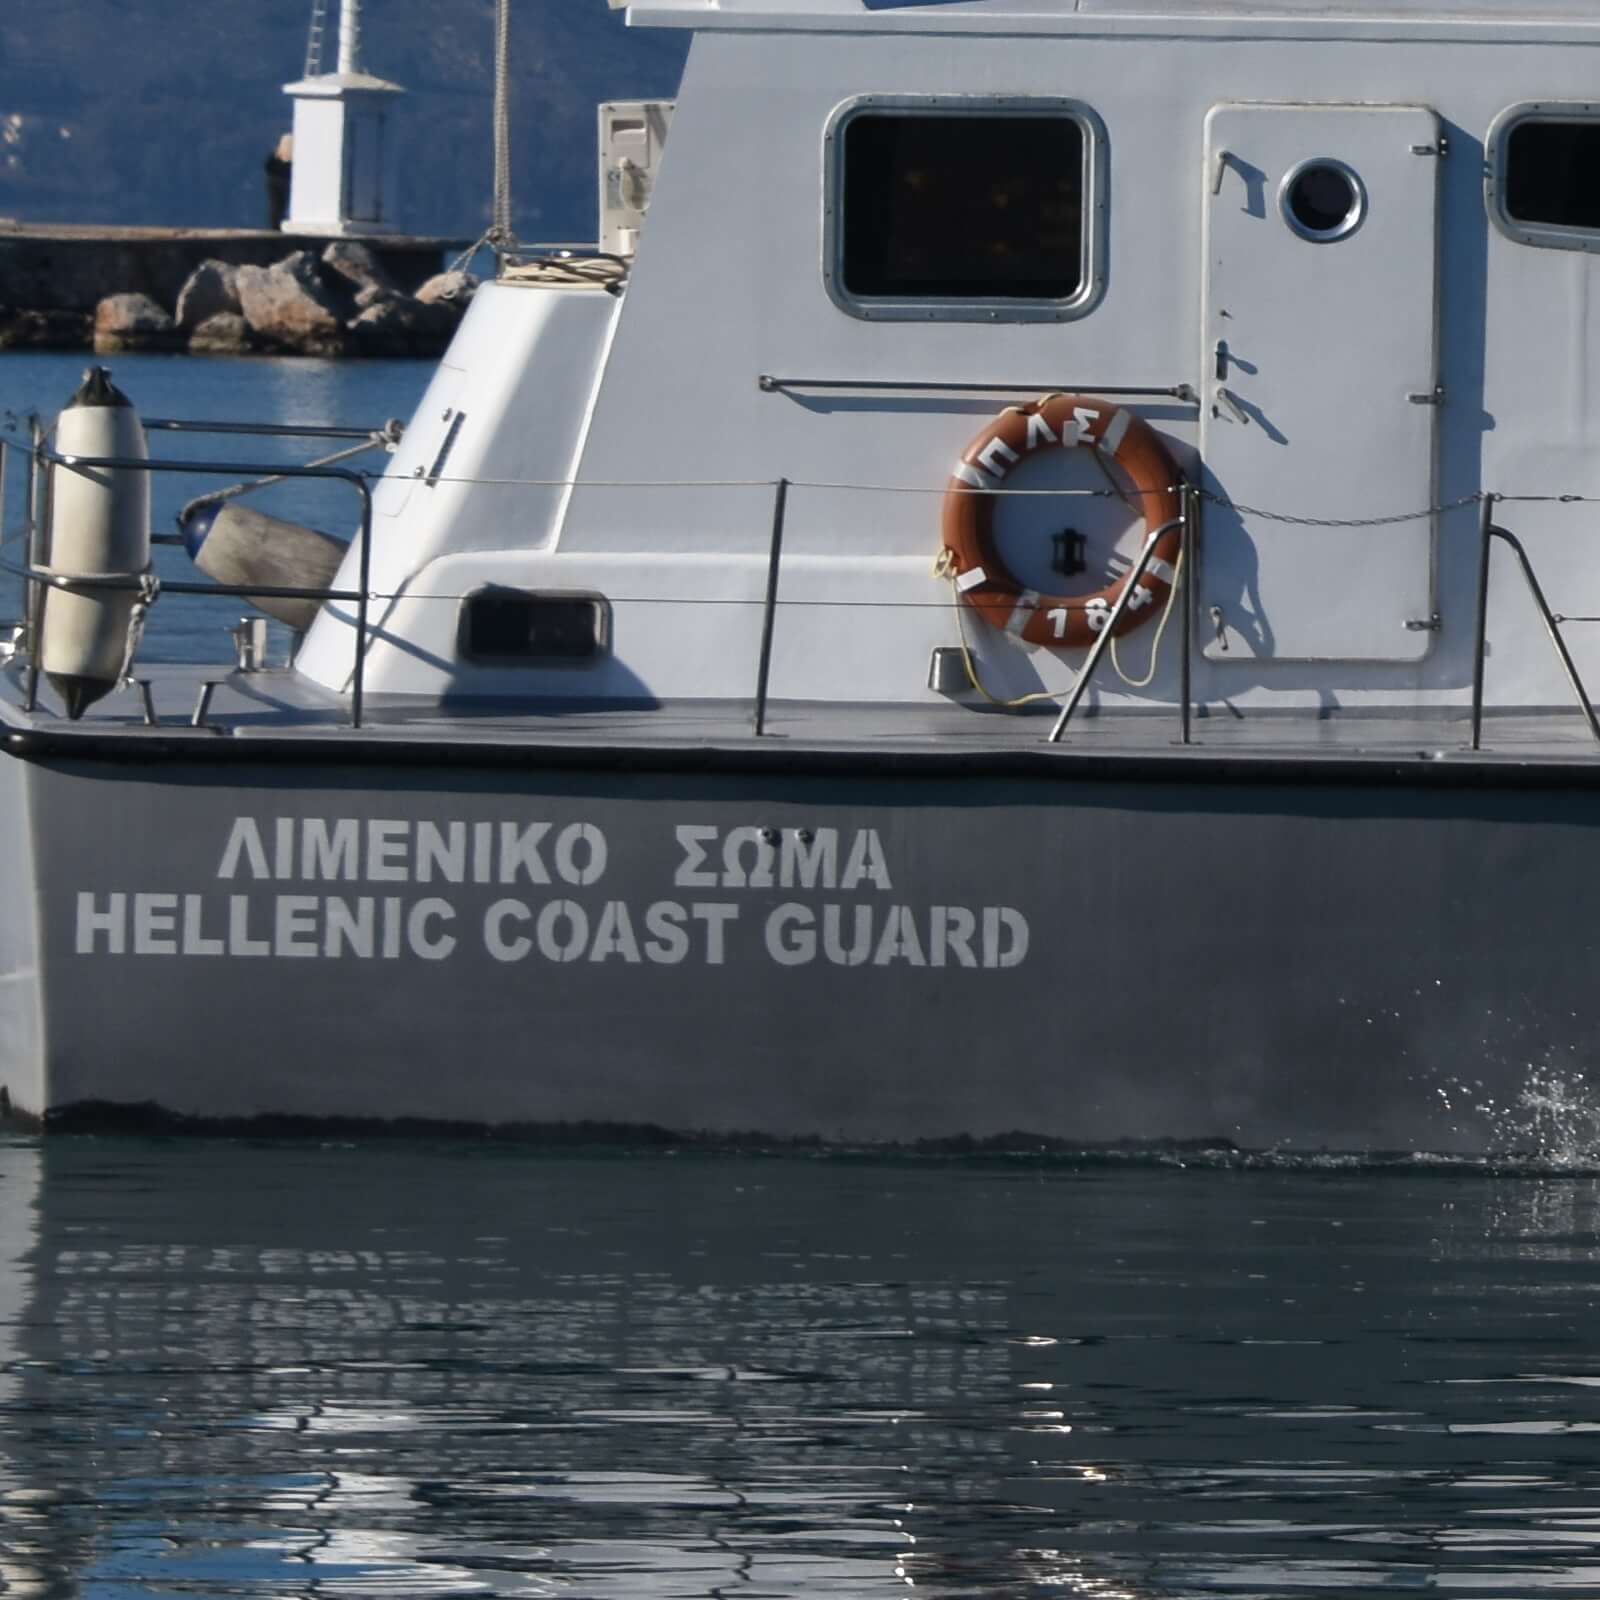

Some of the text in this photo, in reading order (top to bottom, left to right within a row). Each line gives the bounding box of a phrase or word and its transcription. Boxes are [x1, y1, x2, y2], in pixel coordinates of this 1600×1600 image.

[217, 816, 892, 890] ΛΙΜΕΝΙΚΟ ΣΩΜΑ
[75, 891, 1029, 968] HELLENIC COAST GUARD
